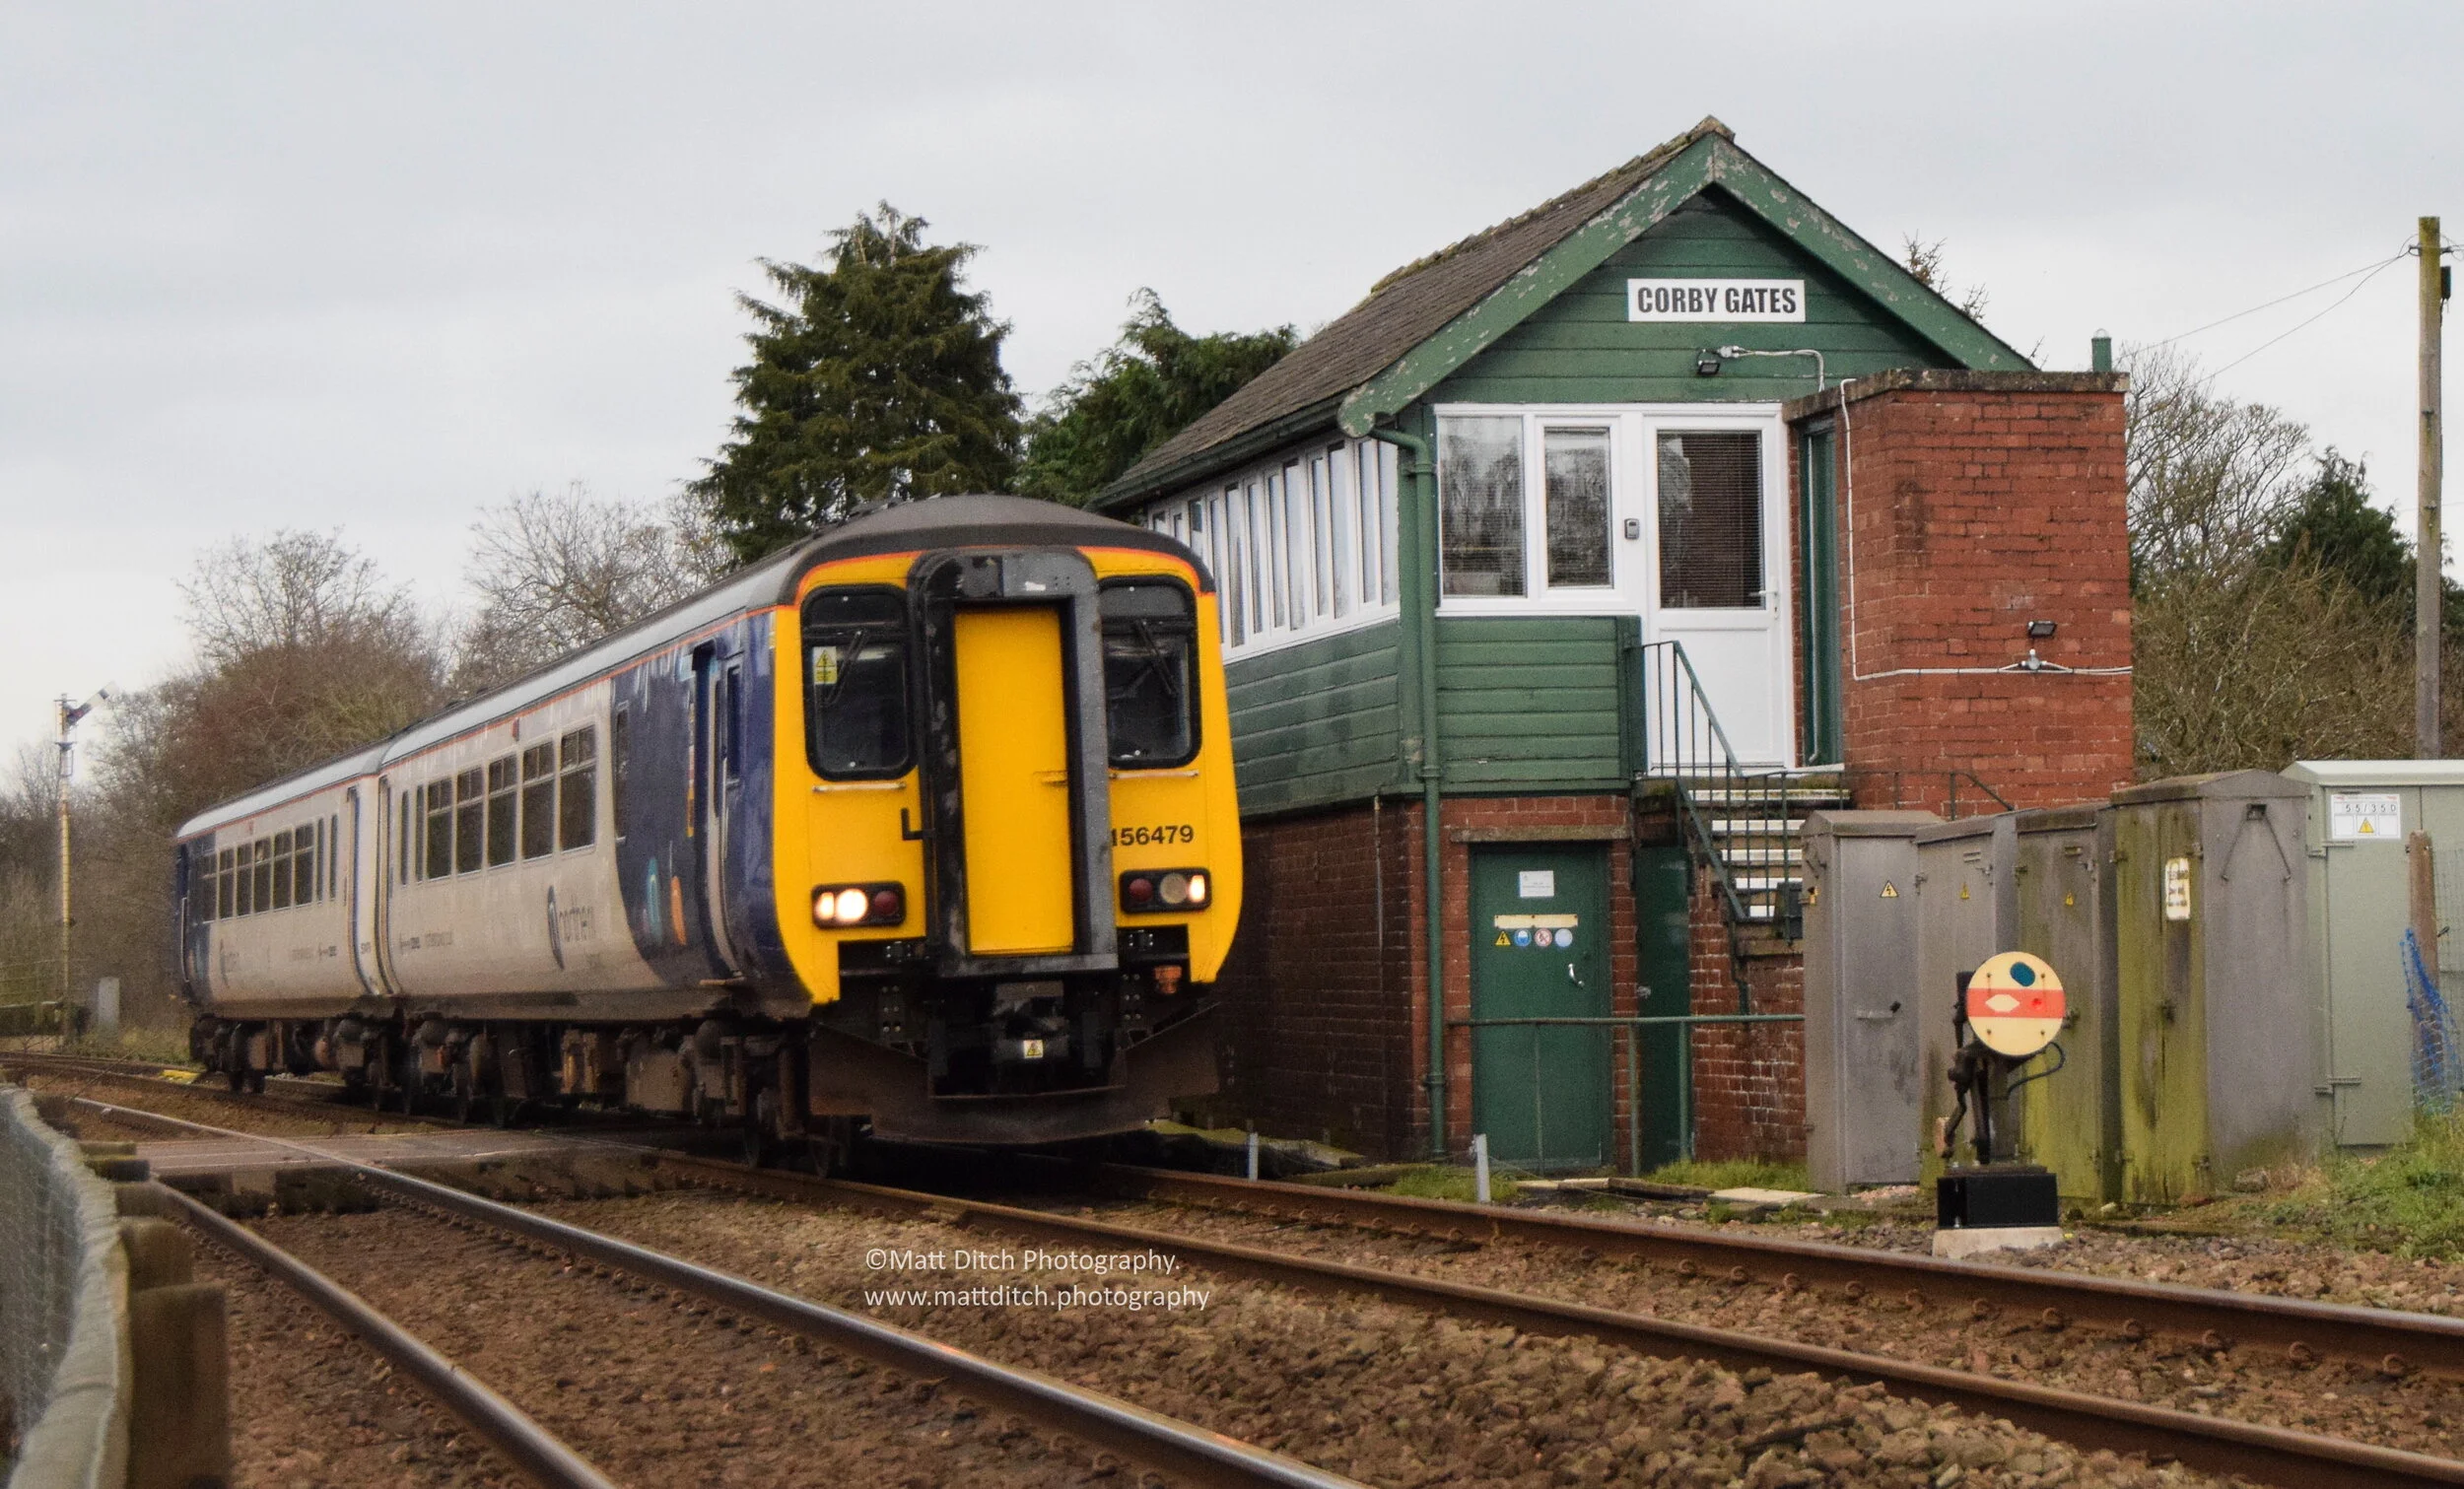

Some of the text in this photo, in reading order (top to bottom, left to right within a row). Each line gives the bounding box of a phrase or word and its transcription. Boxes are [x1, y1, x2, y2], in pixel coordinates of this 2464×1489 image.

[1637, 287, 1797, 314] CORBY GATES
[1111, 825, 1195, 846] 156479
